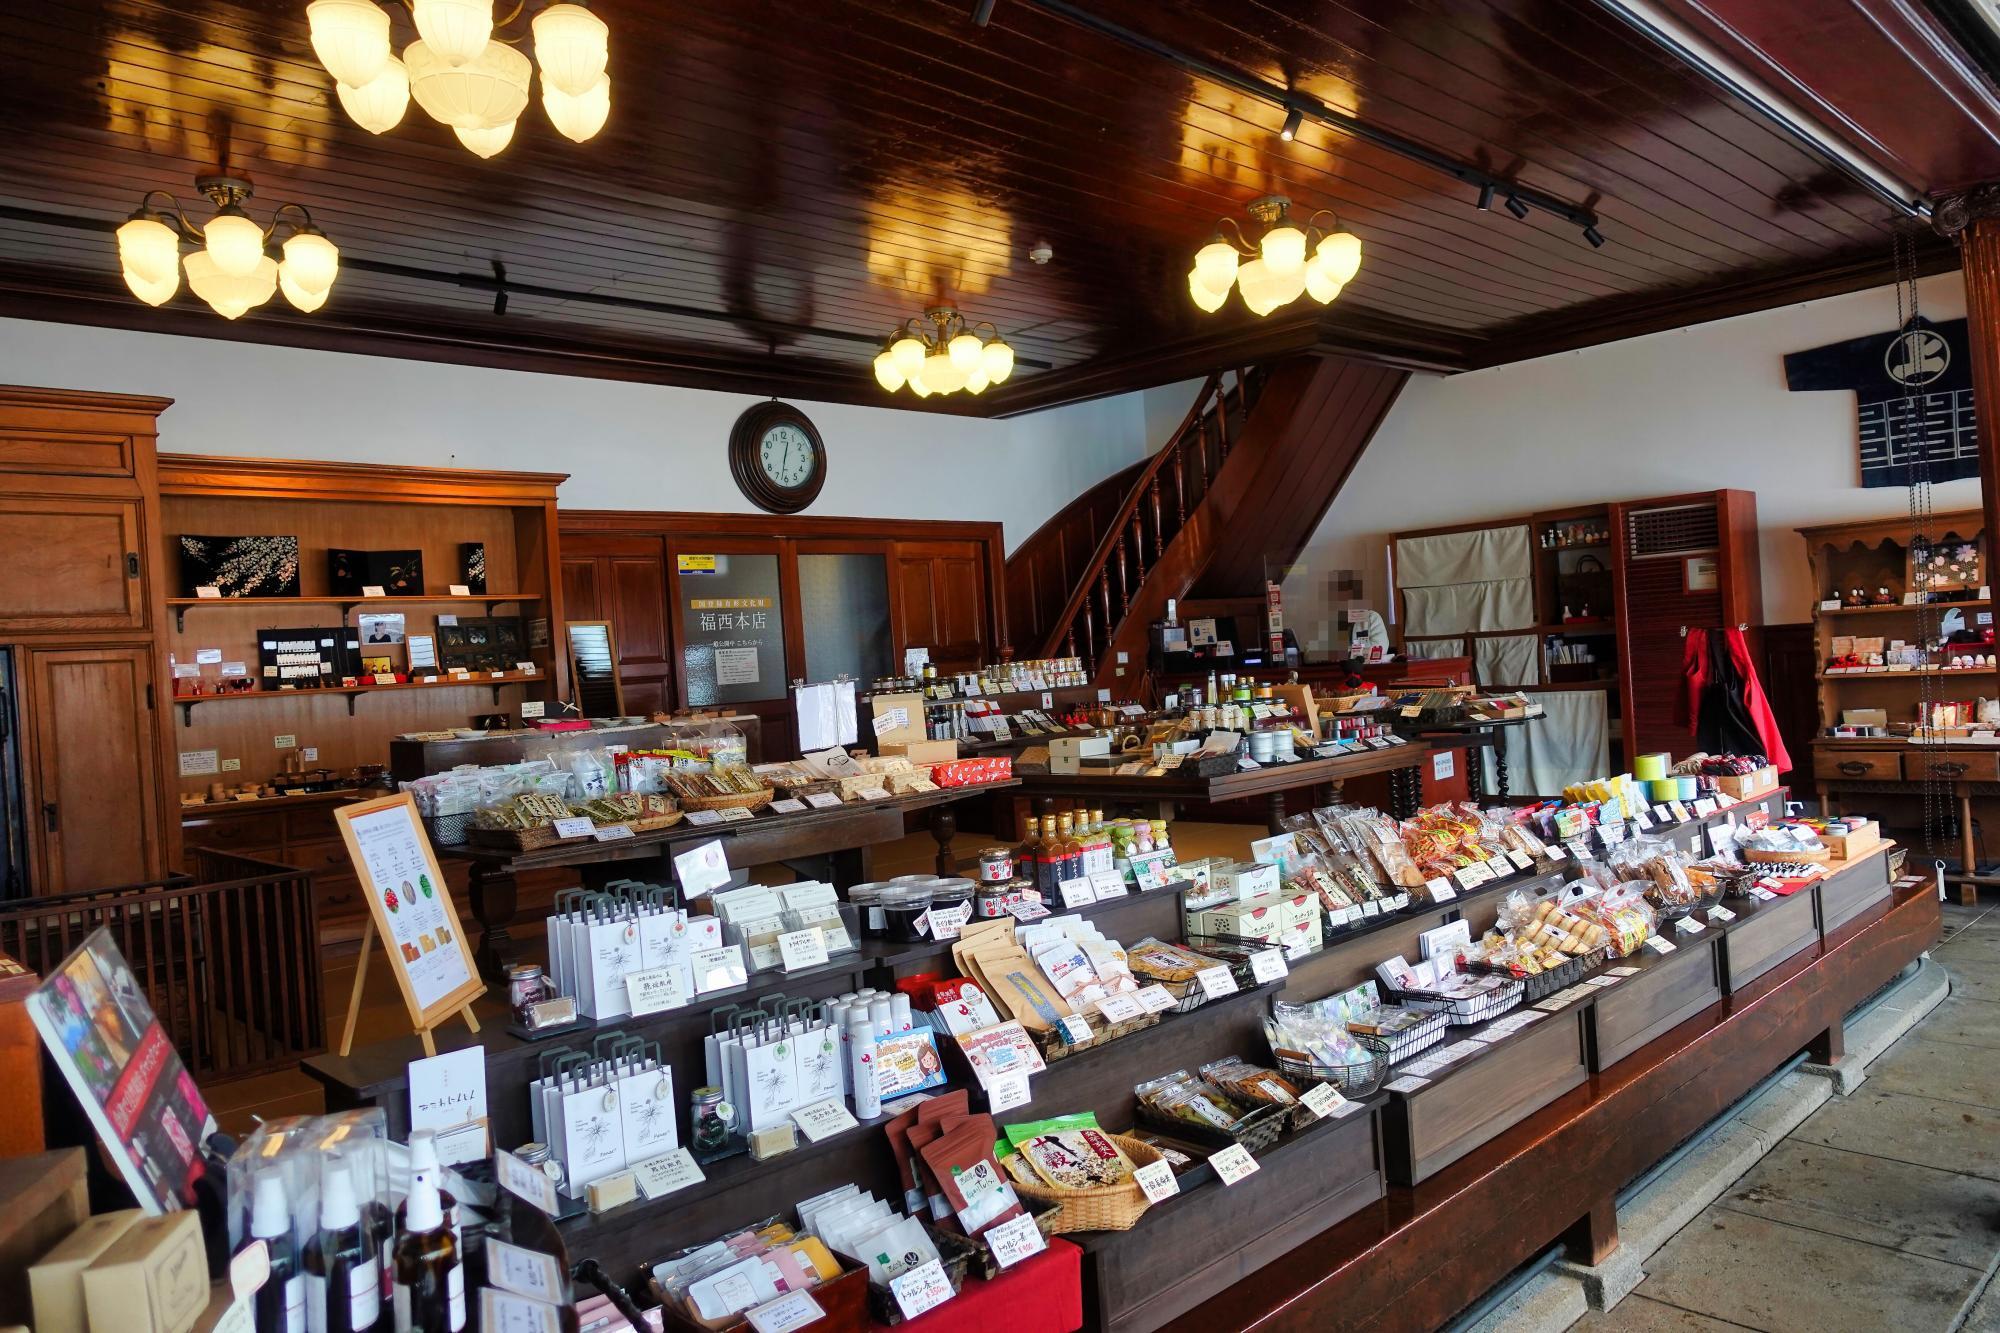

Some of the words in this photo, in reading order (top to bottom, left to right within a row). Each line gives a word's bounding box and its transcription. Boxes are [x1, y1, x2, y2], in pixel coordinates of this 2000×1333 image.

[781, 431, 787, 439] 12
[766, 441, 772, 449] 10
[797, 443, 801, 451] 2
[764, 452, 768, 460] 9
[700, 612, 766, 631] 福西本店
